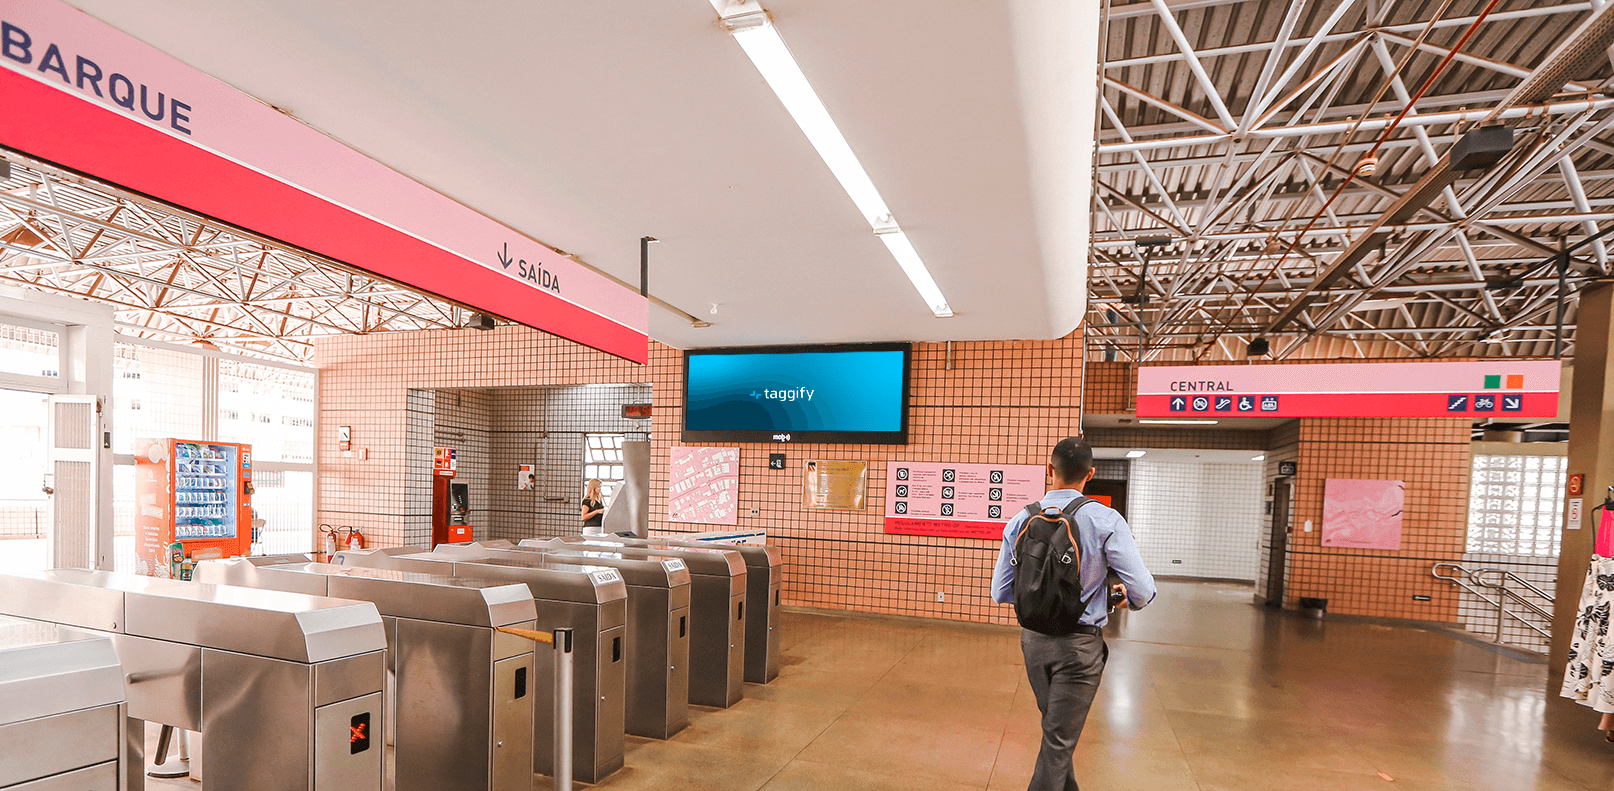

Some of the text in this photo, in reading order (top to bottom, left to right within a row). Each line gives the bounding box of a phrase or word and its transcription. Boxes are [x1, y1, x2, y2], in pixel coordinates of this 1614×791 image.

[518, 258, 561, 293] SAÍDA
[1170, 381, 1234, 392] CENTRAL
[763, 386, 815, 402] taggify
[337, 555, 345, 566] 7
